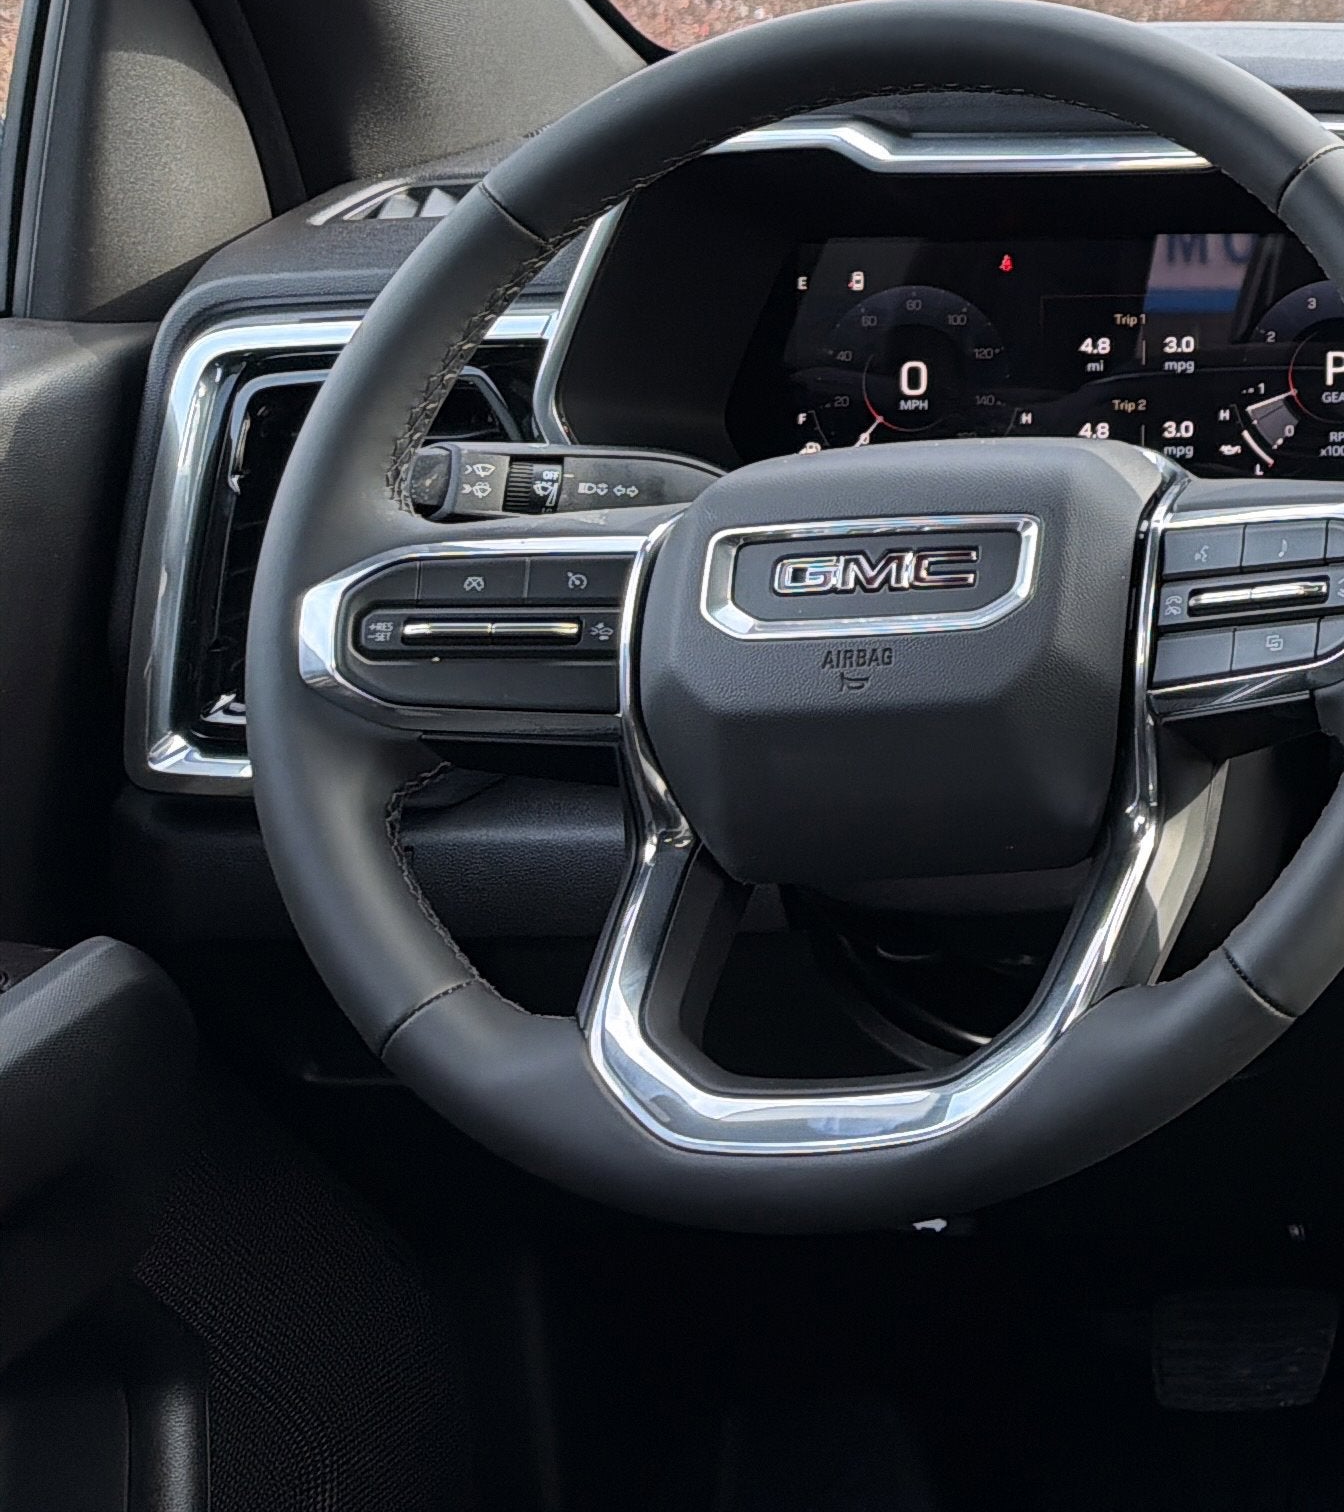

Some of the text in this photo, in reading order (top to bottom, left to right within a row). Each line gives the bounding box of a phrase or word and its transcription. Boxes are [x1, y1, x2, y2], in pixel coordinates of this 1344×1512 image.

[797, 277, 808, 290] E
[1307, 297, 1317, 310] 3
[947, 314, 968, 326] 100
[1114, 313, 1147, 327] Trip 1
[1265, 330, 1276, 343] 2
[1078, 336, 1195, 354] 4.8 3.0
[836, 350, 853, 362] 40
[974, 347, 994, 360] 120
[1086, 360, 1195, 374] mi mpg
[901, 360, 928, 397] 0
[1257, 383, 1265, 395] 1
[834, 396, 850, 407] 20
[900, 399, 929, 411] MPH
[976, 394, 995, 406] 140
[1112, 399, 1147, 413] Trip 2
[797, 413, 807, 425] F
[1020, 413, 1033, 425] H
[1219, 409, 1230, 422] H
[1078, 420, 1194, 439] 4.8 3.0
[1284, 424, 1295, 437] 0
[1163, 444, 1194, 459] mpg
[1254, 464, 1264, 476] L
[774, 546, 979, 595] GMC
[821, 647, 893, 670] AIRBAG
